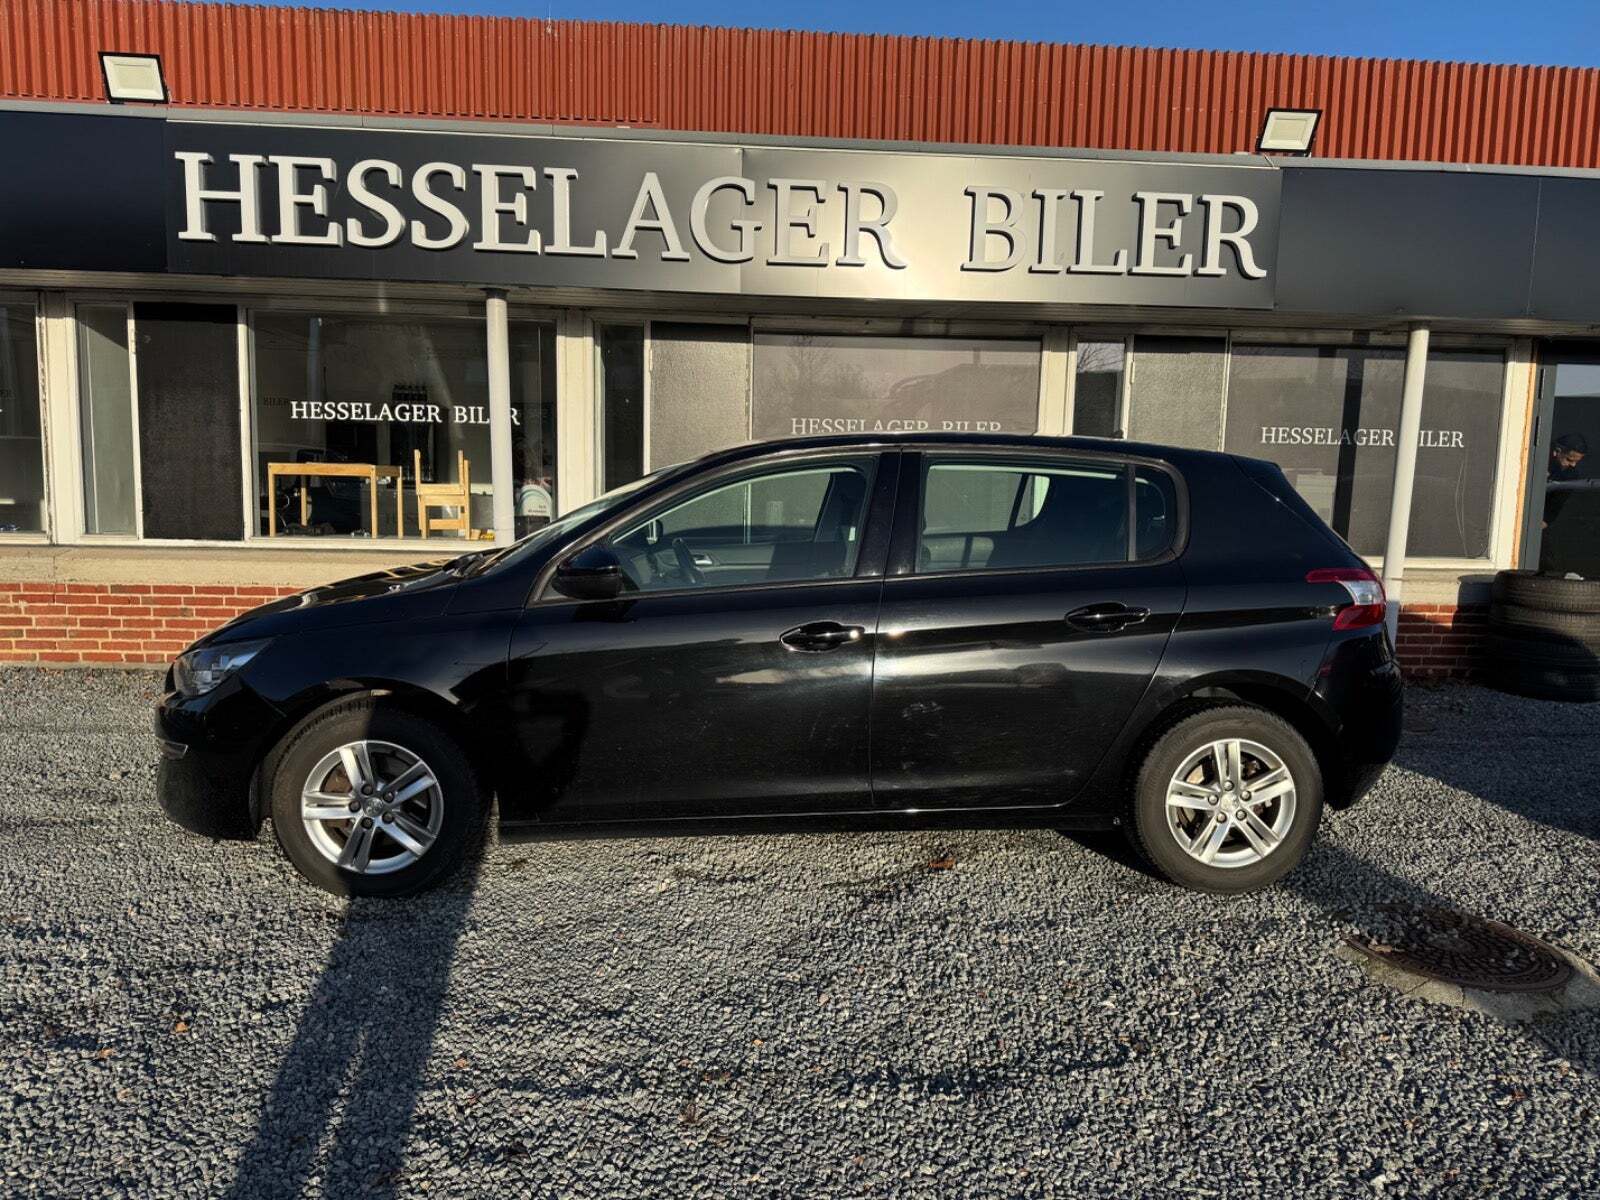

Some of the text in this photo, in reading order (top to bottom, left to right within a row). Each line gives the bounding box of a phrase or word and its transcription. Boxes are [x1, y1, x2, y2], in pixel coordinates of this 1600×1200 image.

[174, 150, 1268, 280] HESSELAGER BILER
[290, 400, 521, 426] HESSELAGER BILR
[1260, 425, 1465, 448] HESSELAGER ILER
